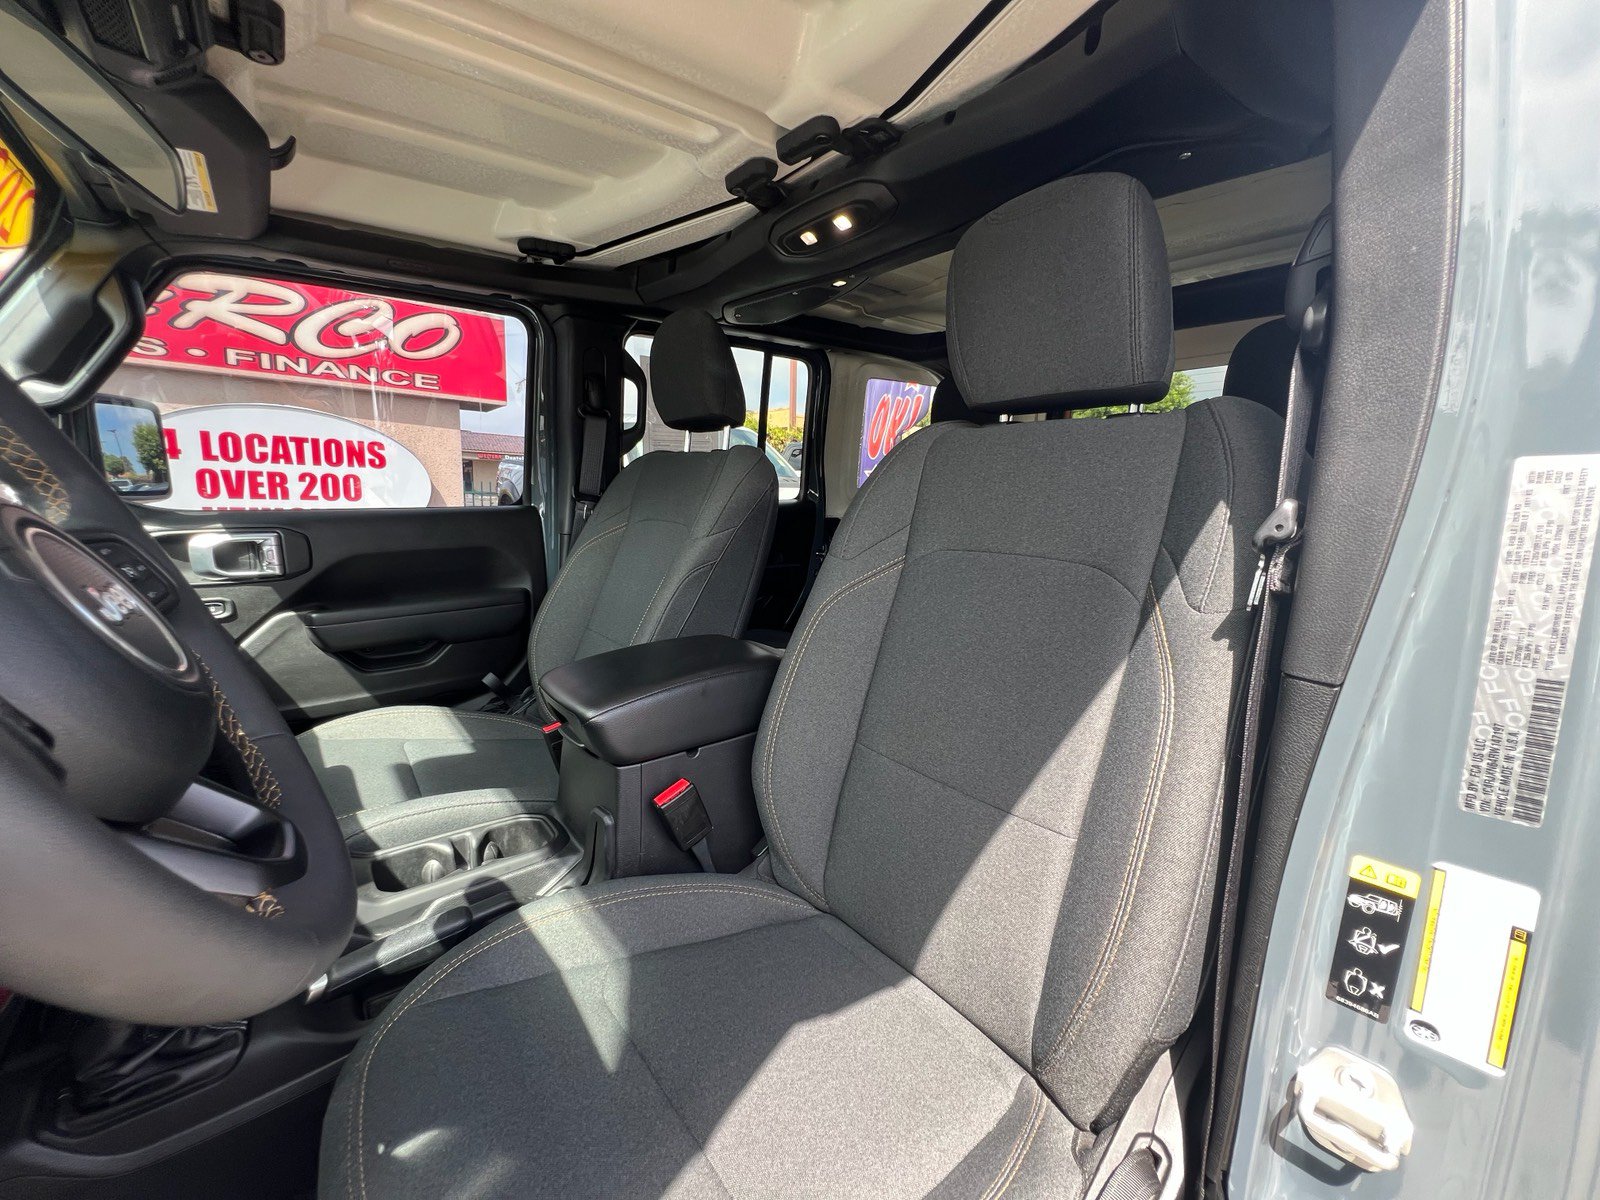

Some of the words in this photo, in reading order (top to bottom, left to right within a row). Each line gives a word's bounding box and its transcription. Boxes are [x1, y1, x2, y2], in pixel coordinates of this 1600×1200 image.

[224, 348, 440, 391] FINANCE
[199, 430, 387, 469] LOCATIONS
[195, 468, 290, 500] OVER
[298, 472, 363, 502] 200
[1547, 640, 1557, 659] VEHICLE
[1567, 528, 1578, 549] FEDERAL
[1575, 488, 1585, 507] VEHICLE
[1572, 568, 1581, 581] DATE
[1570, 583, 1578, 591] THE
[1565, 602, 1575, 618] EFFECT
[1474, 738, 1486, 751] LLC
[1505, 729, 1520, 751] U.S.A.
[1472, 752, 1484, 762] US
[1482, 722, 1504, 796] 1C4RJXN64RW147197
[1503, 753, 1515, 763] IN:
[1470, 764, 1482, 778] FCA
[1499, 765, 1513, 786] MADE
[1467, 780, 1479, 792] BY:
[1465, 793, 1477, 809] MFD
[1479, 798, 1492, 813] VIN:
[1494, 787, 1509, 816] VEHICLE
